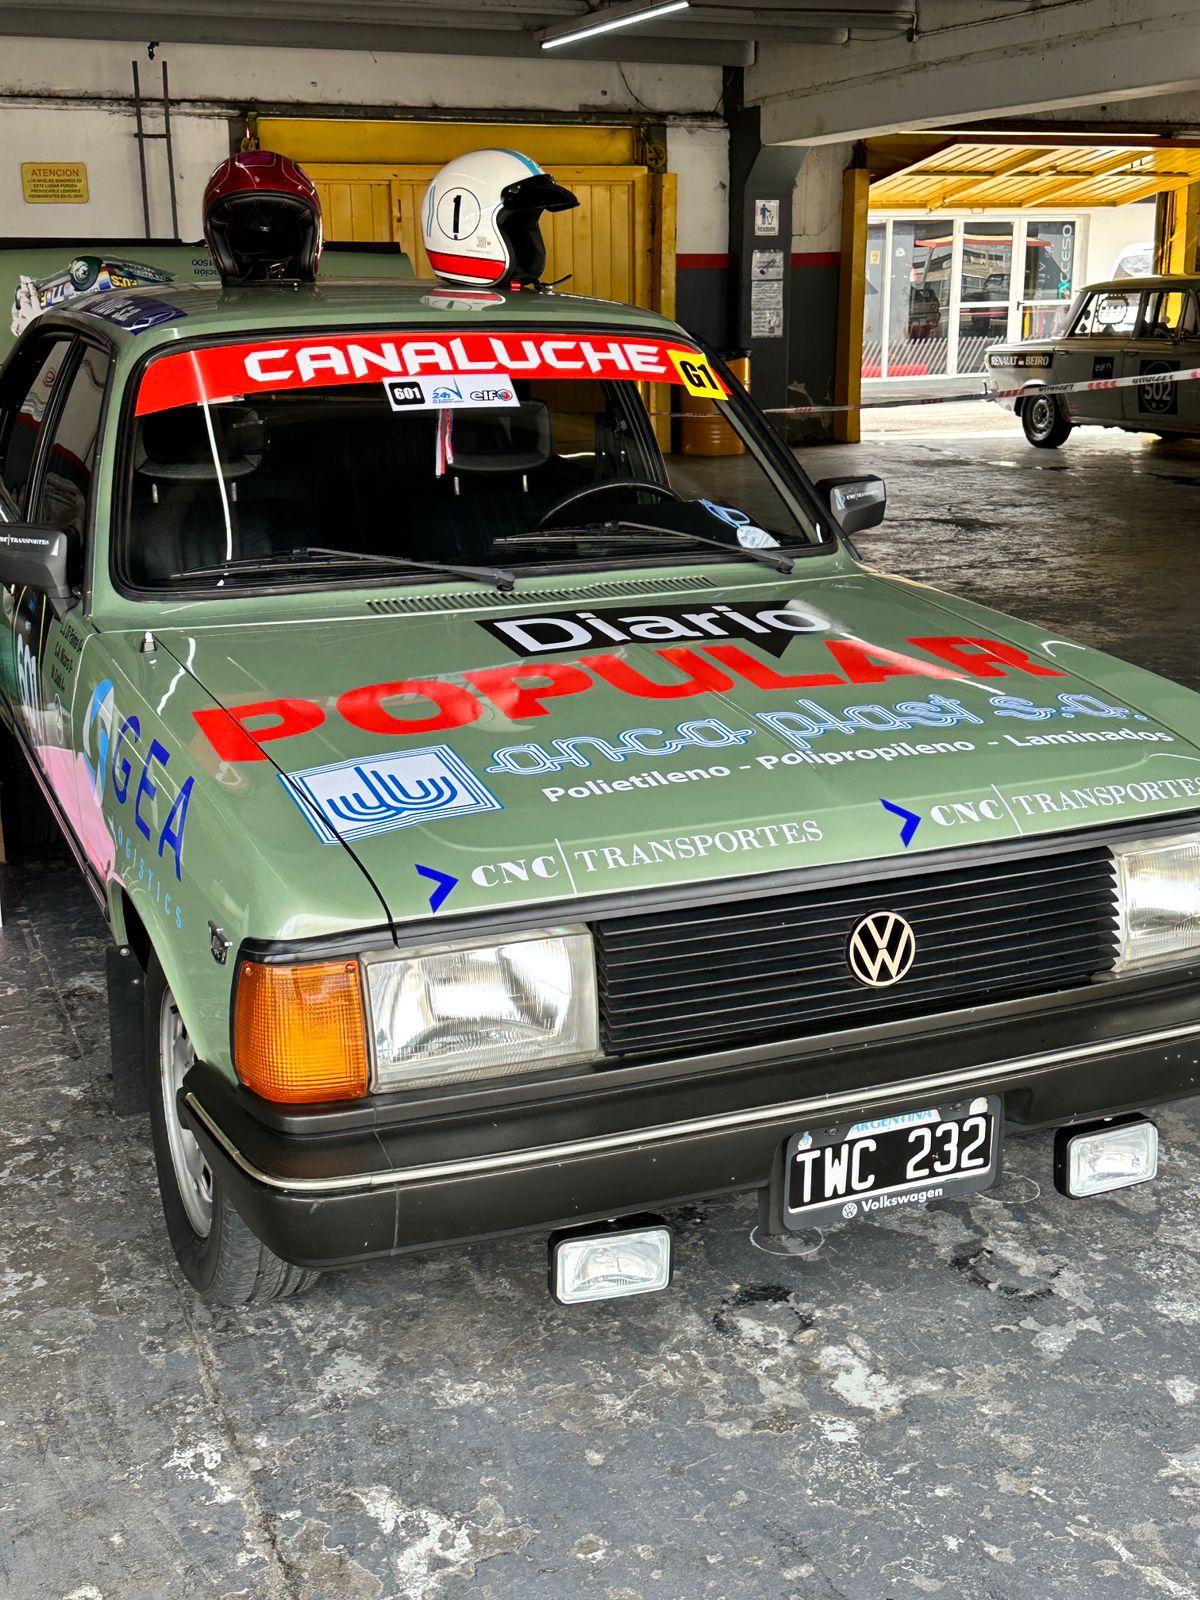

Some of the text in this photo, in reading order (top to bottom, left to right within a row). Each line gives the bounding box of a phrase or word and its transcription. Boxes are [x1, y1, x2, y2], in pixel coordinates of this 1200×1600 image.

[31, 168, 79, 177] ATENCION
[453, 195, 462, 234] 1
[243, 337, 667, 383] CANALUCHE
[679, 360, 719, 391] G1
[990, 356, 1017, 366] RENAULT
[1025, 355, 1050, 366] BEIRO
[394, 387, 421, 400] 601
[470, 389, 498, 401] elf
[493, 605, 832, 652] Diario
[190, 635, 1068, 761] POPULAR
[483, 719, 756, 775] anca
[754, 693, 985, 750] plast
[541, 764, 731, 802] Polietileno
[755, 738, 976, 771] Polipropileno
[1003, 728, 1174, 748] Laminados
[111, 715, 195, 882] GEA
[929, 799, 1005, 827] CNC
[111, 815, 183, 929] LOGISTICS
[471, 820, 823, 889] CNC TRANSPORTES
[796, 1116, 987, 1203] TWC 232
[861, 1187, 943, 1213] Volkswagen
